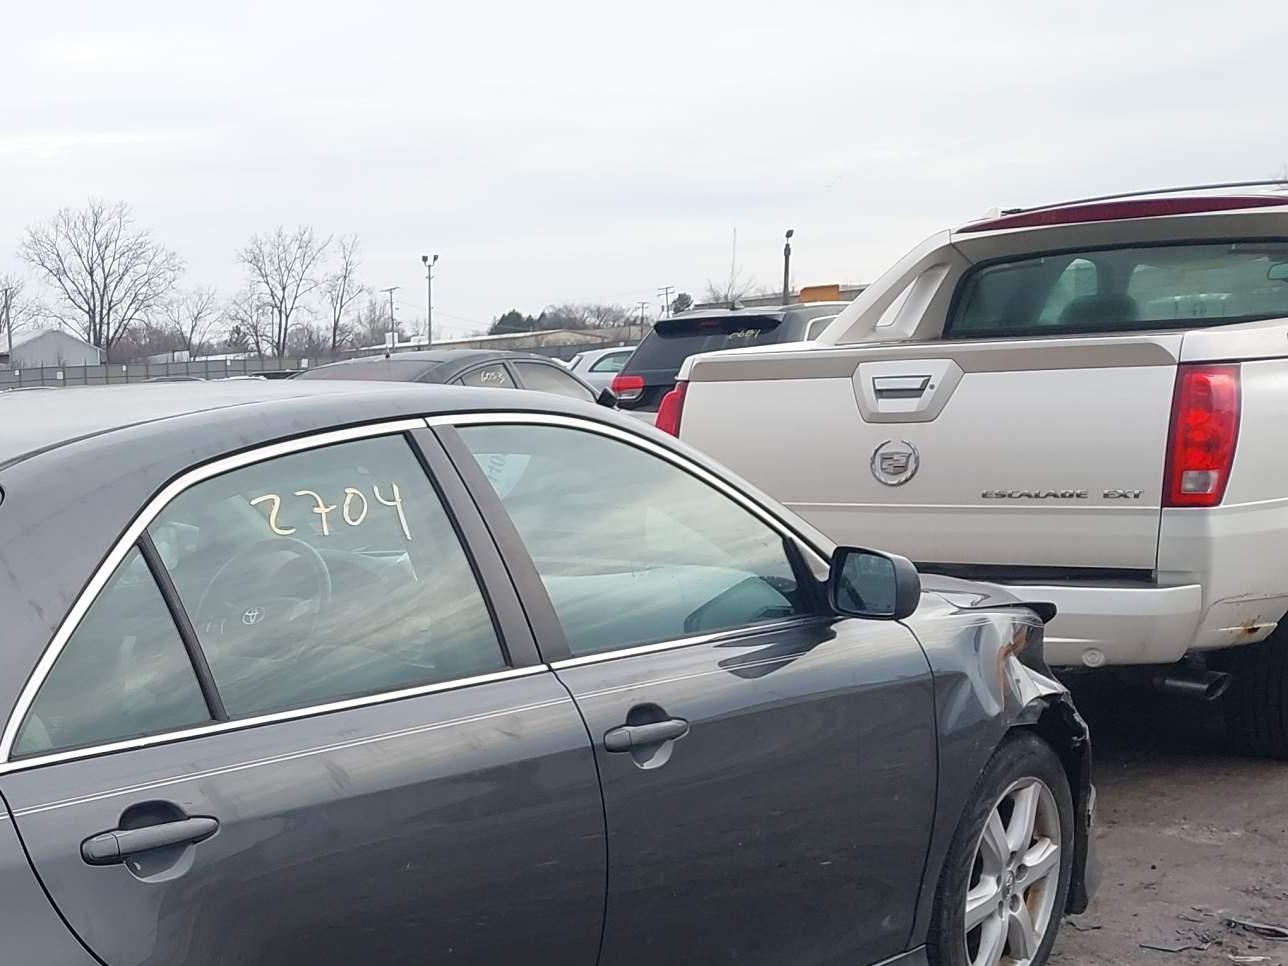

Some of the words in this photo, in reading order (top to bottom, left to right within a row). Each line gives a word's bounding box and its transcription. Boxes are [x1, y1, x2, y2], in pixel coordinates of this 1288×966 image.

[250, 481, 412, 541] 2704
[981, 489, 1088, 499] ESCALADE
[1103, 489, 1144, 499] EXT
